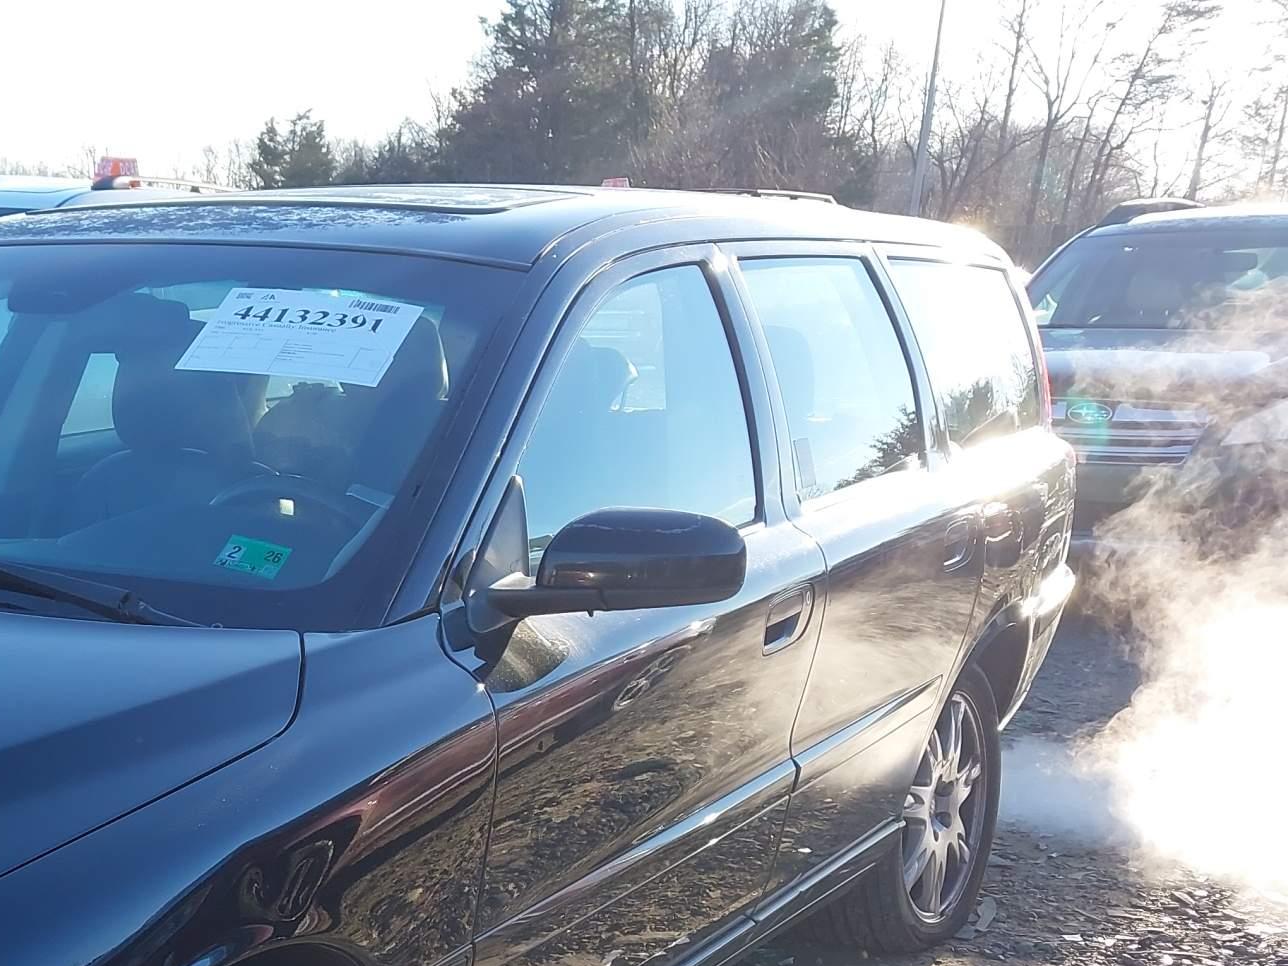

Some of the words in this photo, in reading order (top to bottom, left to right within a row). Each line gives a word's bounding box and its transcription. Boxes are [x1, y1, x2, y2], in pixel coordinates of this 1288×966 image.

[233, 305, 384, 333] 44132391
[226, 545, 242, 559] 2
[264, 550, 283, 564] 26
